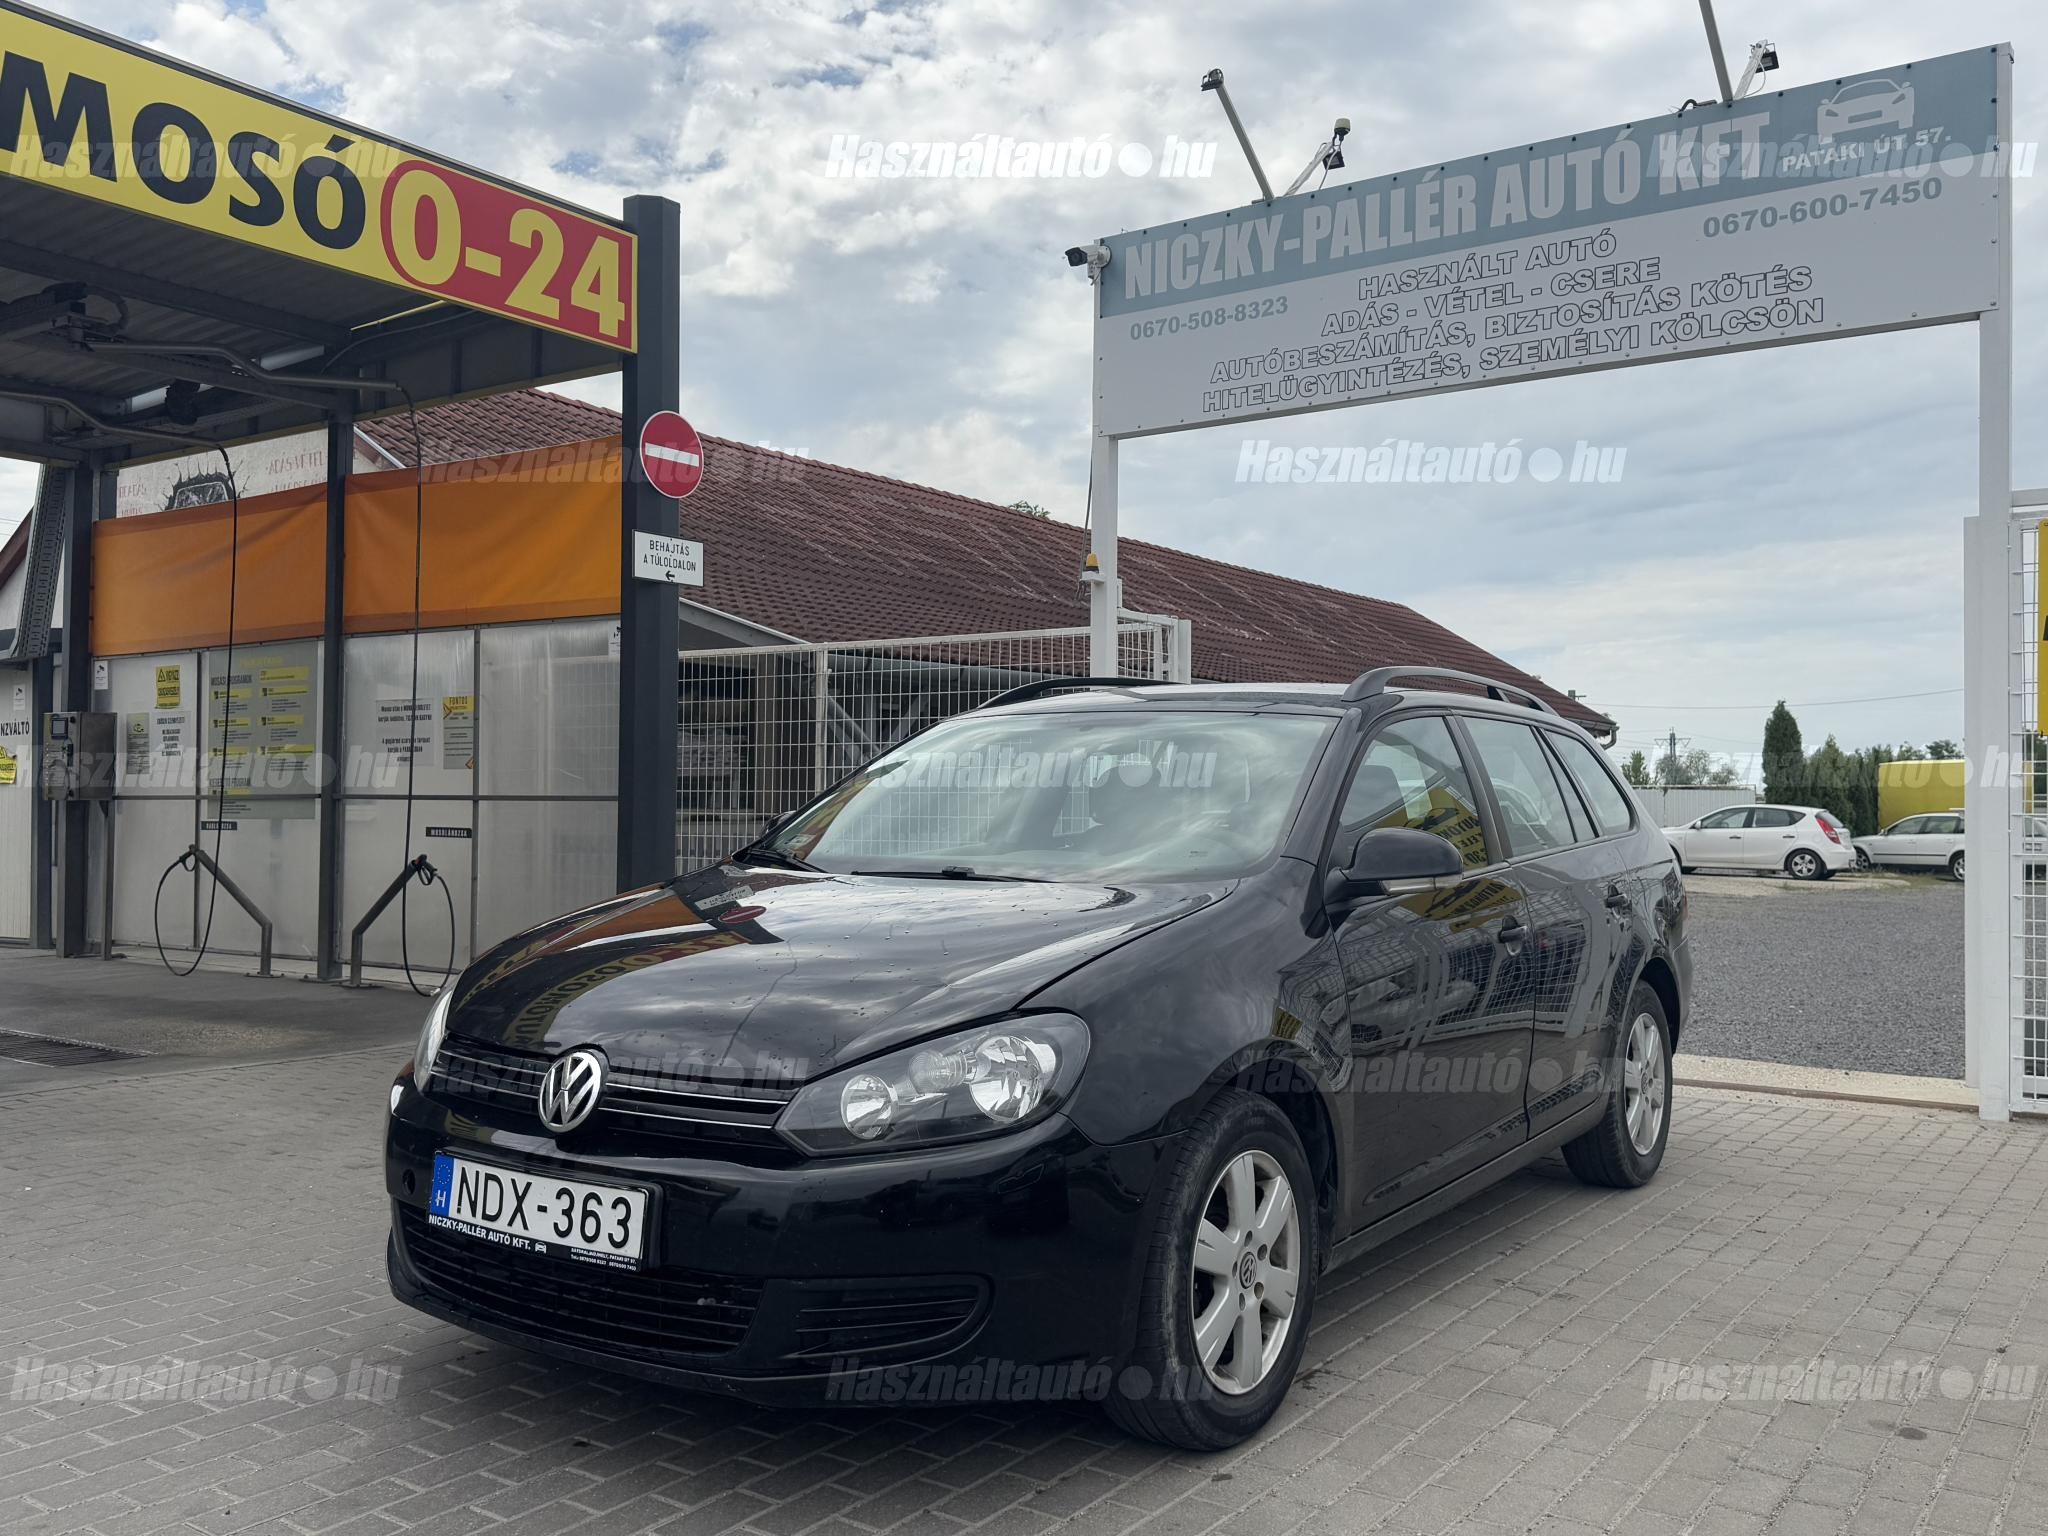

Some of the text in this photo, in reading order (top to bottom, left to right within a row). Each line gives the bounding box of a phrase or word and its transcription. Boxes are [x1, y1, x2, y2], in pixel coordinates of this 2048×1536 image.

[1782, 127, 1951, 172] PATAKI ÚT 57.
[0, 50, 625, 338] MOSÓ 0-24
[1125, 112, 1770, 300] NICZKY-PALLÉR AUTÓ KFT
[1703, 177, 1942, 238] 0670-600-7450
[1321, 301, 1399, 336] ADÁS
[1424, 282, 1523, 318] VÉTEL
[1551, 256, 1660, 296] CSERE
[1359, 228, 1616, 300] HASZNÁLT AUTÓ
[1130, 296, 1288, 340] 0670-508-8323
[1210, 264, 1812, 384] AUTÓBESZÁMÍTÁS, BIZTOSÍTÁS KÖTÉS
[1203, 298, 1823, 412] HITELÜGYINTÉZÉS, SZEMÉLYI KÖLCSÖN
[643, 552, 697, 572] A TÚLOLDALON
[649, 539, 690, 556] BEHAJTÁS
[428, 1214, 531, 1250] NICZKY-PALLÉR AUTÓ KFT.
[436, 1190, 448, 1208] H
[456, 1167, 632, 1249] NDX-363
